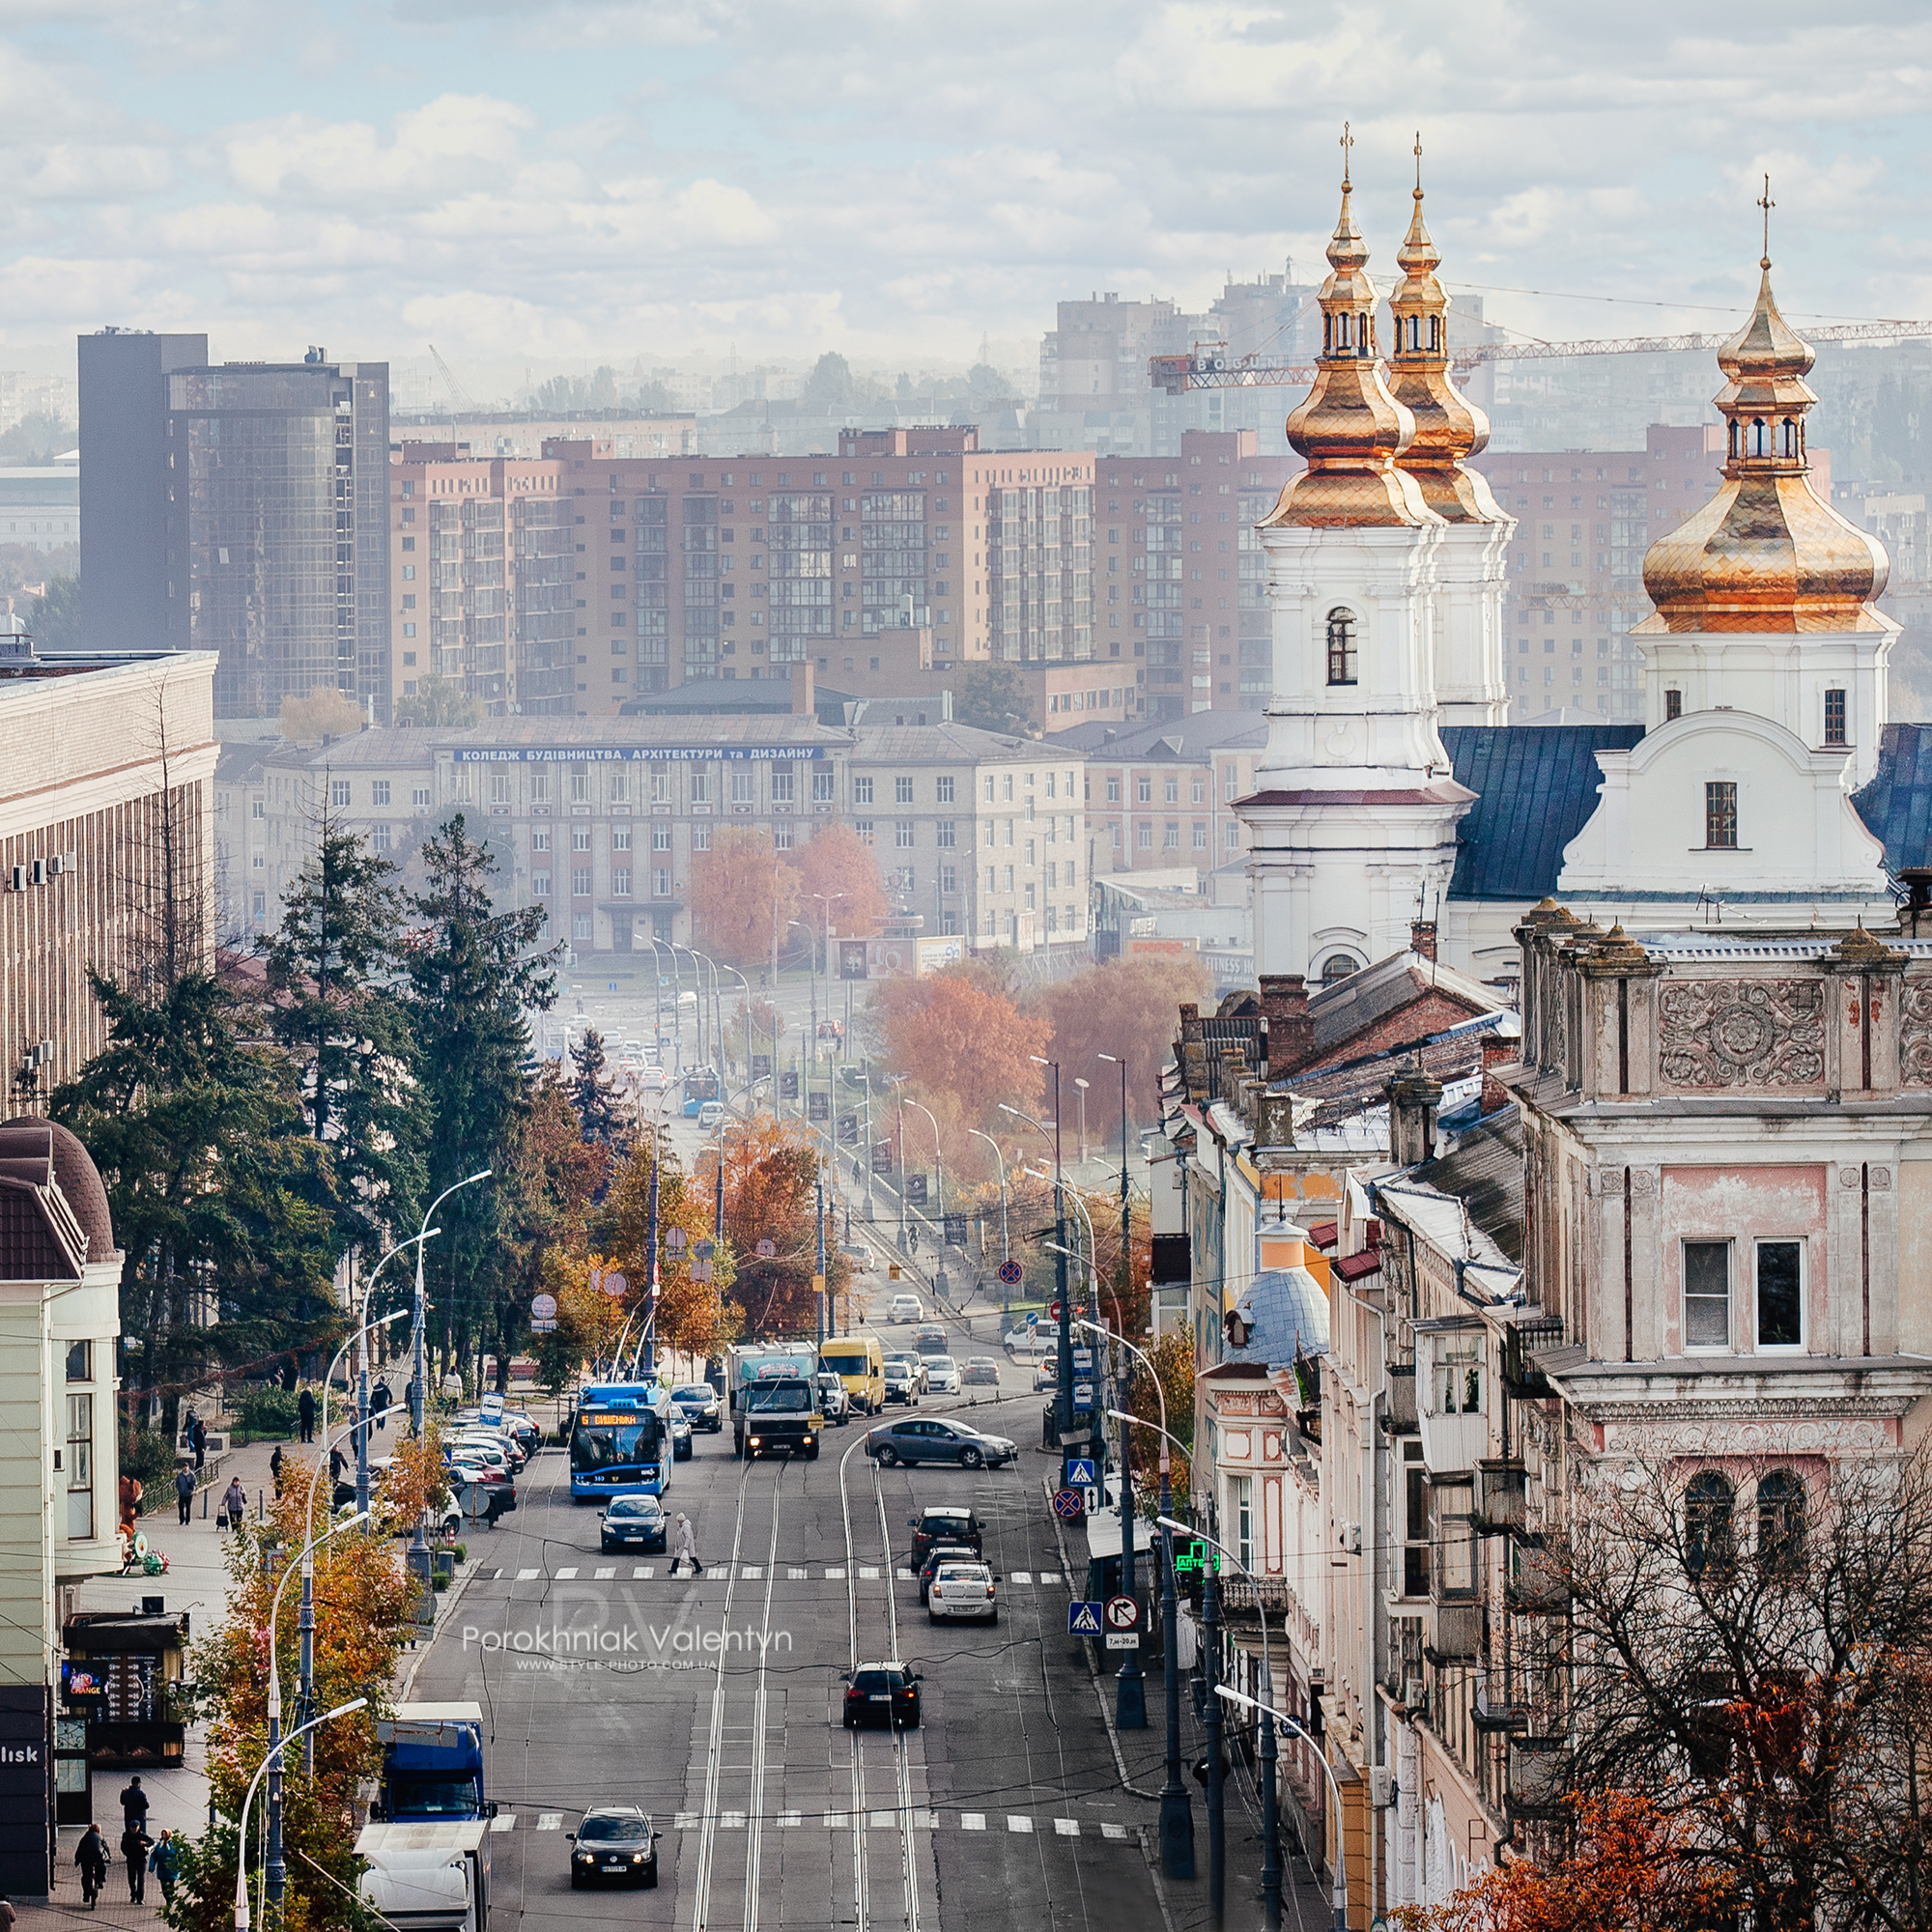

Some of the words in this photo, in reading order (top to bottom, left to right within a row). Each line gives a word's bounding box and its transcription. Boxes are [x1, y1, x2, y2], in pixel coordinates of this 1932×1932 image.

[1197, 356, 1278, 371] BOGUN
[462, 750, 521, 761] КОЛЕДЖ
[632, 748, 723, 760] АРХІТЕКТУРИ
[729, 751, 744, 759] та
[750, 747, 814, 760] ДИЗАЙНУ
[1206, 956, 1240, 974] FITNESS
[1179, 1558, 1216, 1568] АПТЕ
